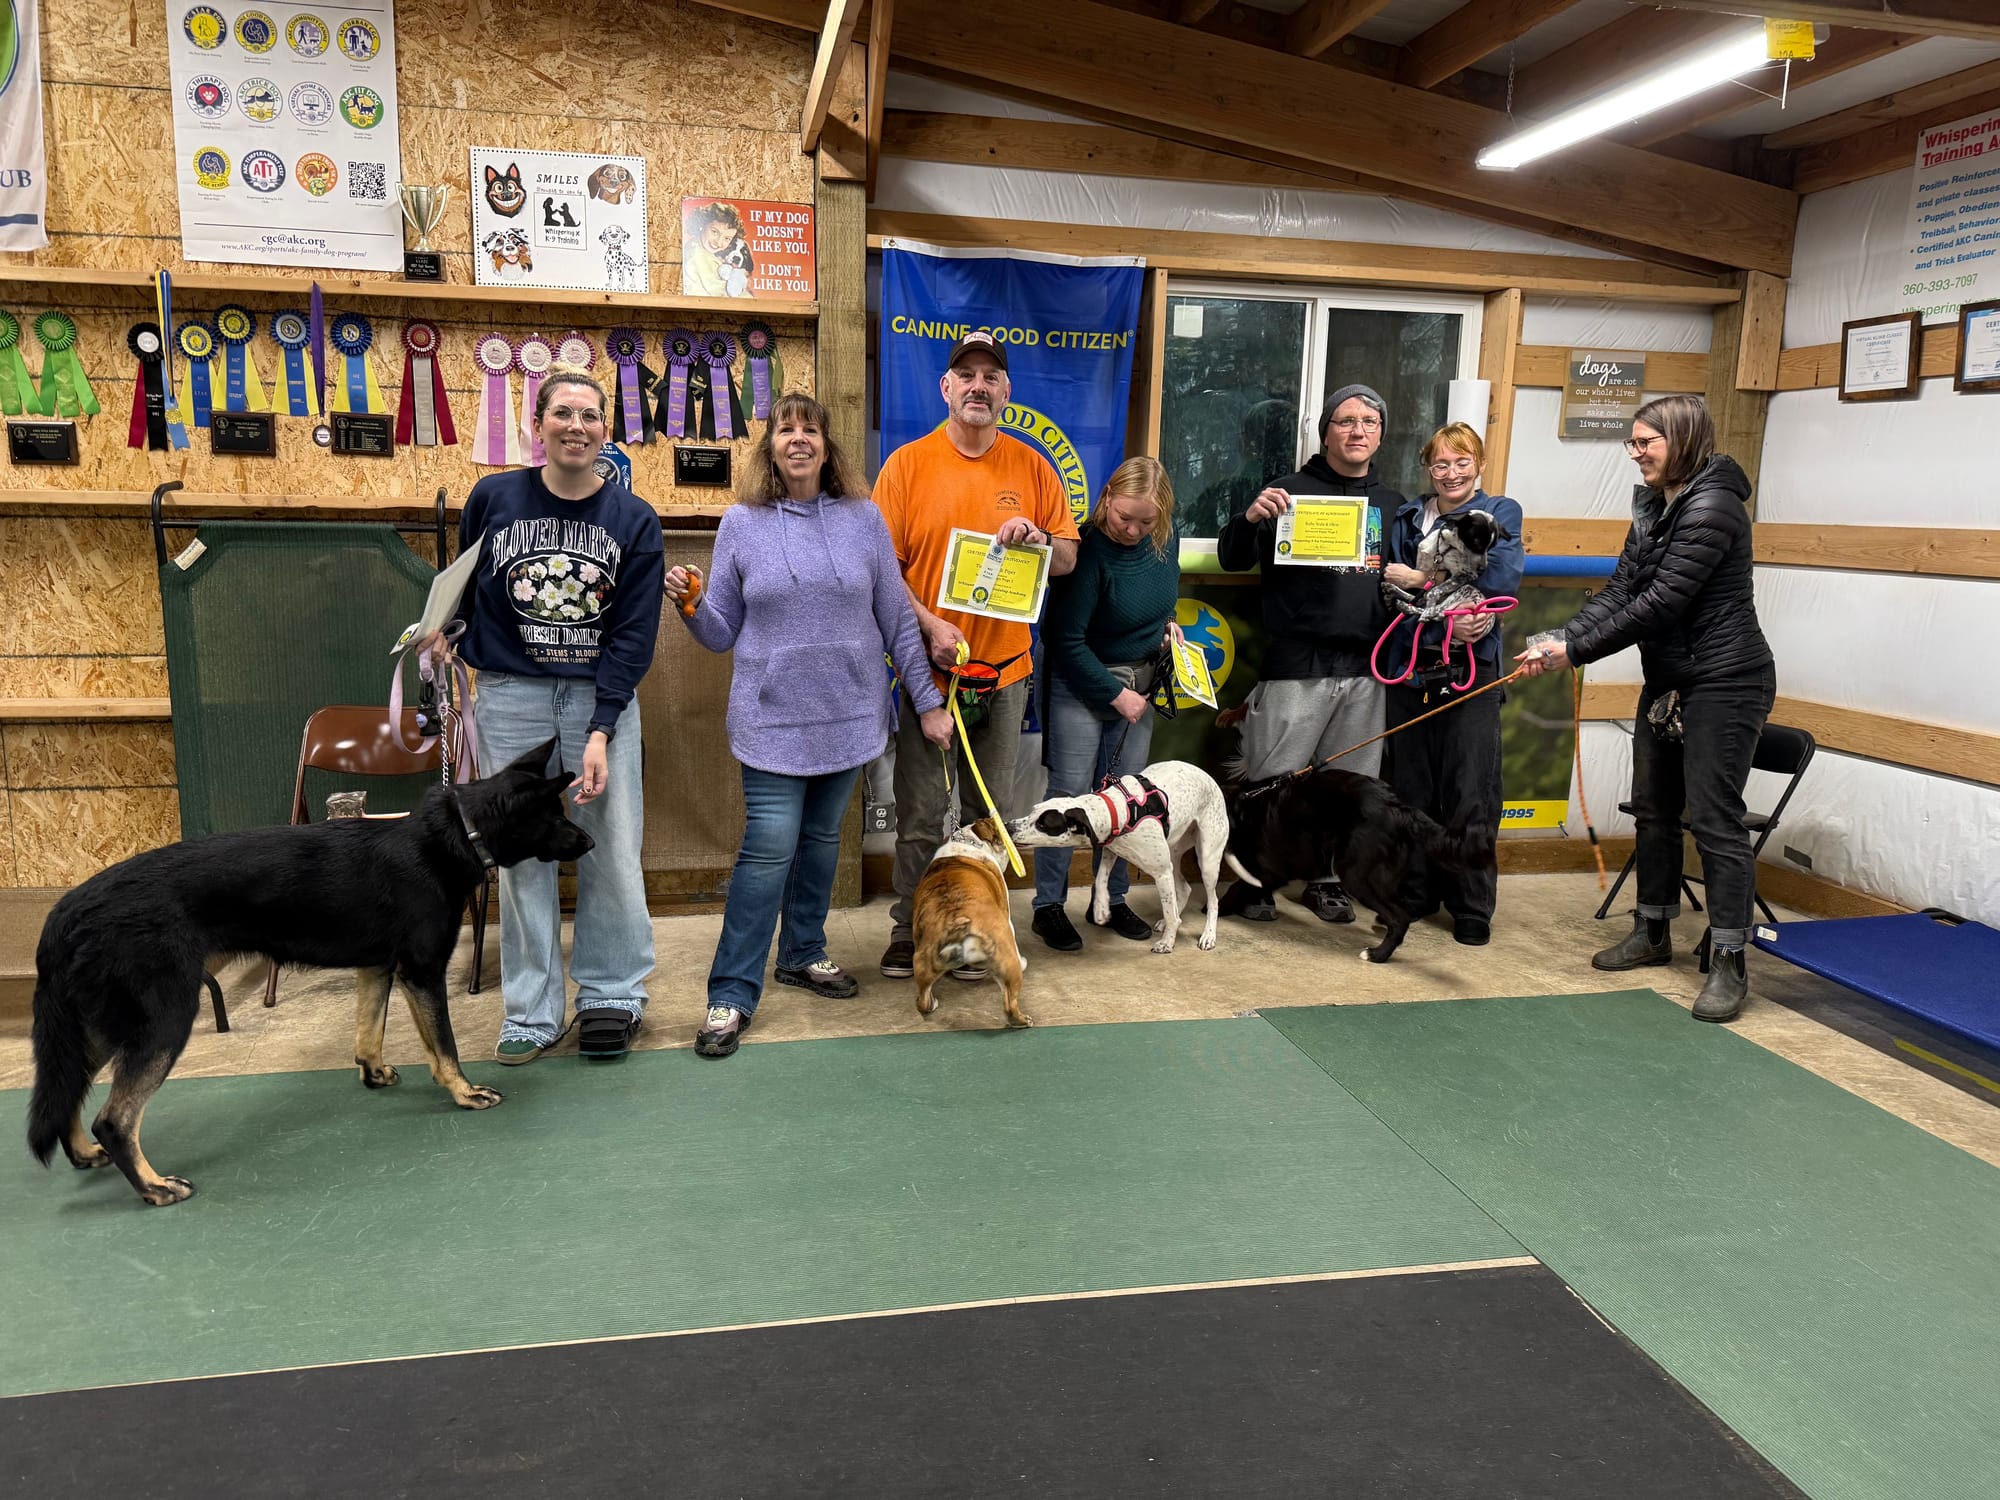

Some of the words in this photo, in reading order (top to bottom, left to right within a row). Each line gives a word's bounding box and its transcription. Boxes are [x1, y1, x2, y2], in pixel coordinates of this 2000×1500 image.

[1925, 118, 2000, 149] Whisperin
[1922, 142, 1984, 167] Training
[254, 160, 273, 178] ATT
[0, 169, 32, 188] UB
[536, 174, 579, 184] SMILES
[1916, 198, 1933, 209] and
[1958, 202, 2000, 214] Obedien
[750, 210, 762, 222] IF
[764, 211, 783, 223] MY
[786, 212, 810, 224] DOG
[1958, 216, 2000, 231] Behavior
[756, 226, 804, 239] DOESN'T
[261, 234, 326, 248] cgc@akc.org
[752, 240, 782, 252] LIKE
[784, 242, 810, 256] YOU,
[1917, 240, 1953, 254] Certified
[1955, 235, 1971, 246] AKC
[1974, 230, 2000, 242] Canin
[1915, 260, 1932, 270] and
[1935, 256, 1955, 266] Trick
[1957, 248, 1996, 262] Evaluator
[760, 264, 765, 275] I
[768, 264, 802, 277] DON'T
[753, 278, 782, 290] LIKE
[785, 280, 811, 292] YOU.
[1902, 273, 1978, 296] 360-393-7097
[891, 315, 971, 340] CANINE
[978, 326, 1039, 346] OOD
[1579, 354, 1622, 387] dogs
[1604, 399, 1621, 408] they
[1002, 406, 1036, 430] OD
[1041, 426, 1086, 527] CITIZEN
[563, 628, 602, 645] DAILY
[1500, 808, 1536, 818] 1995
